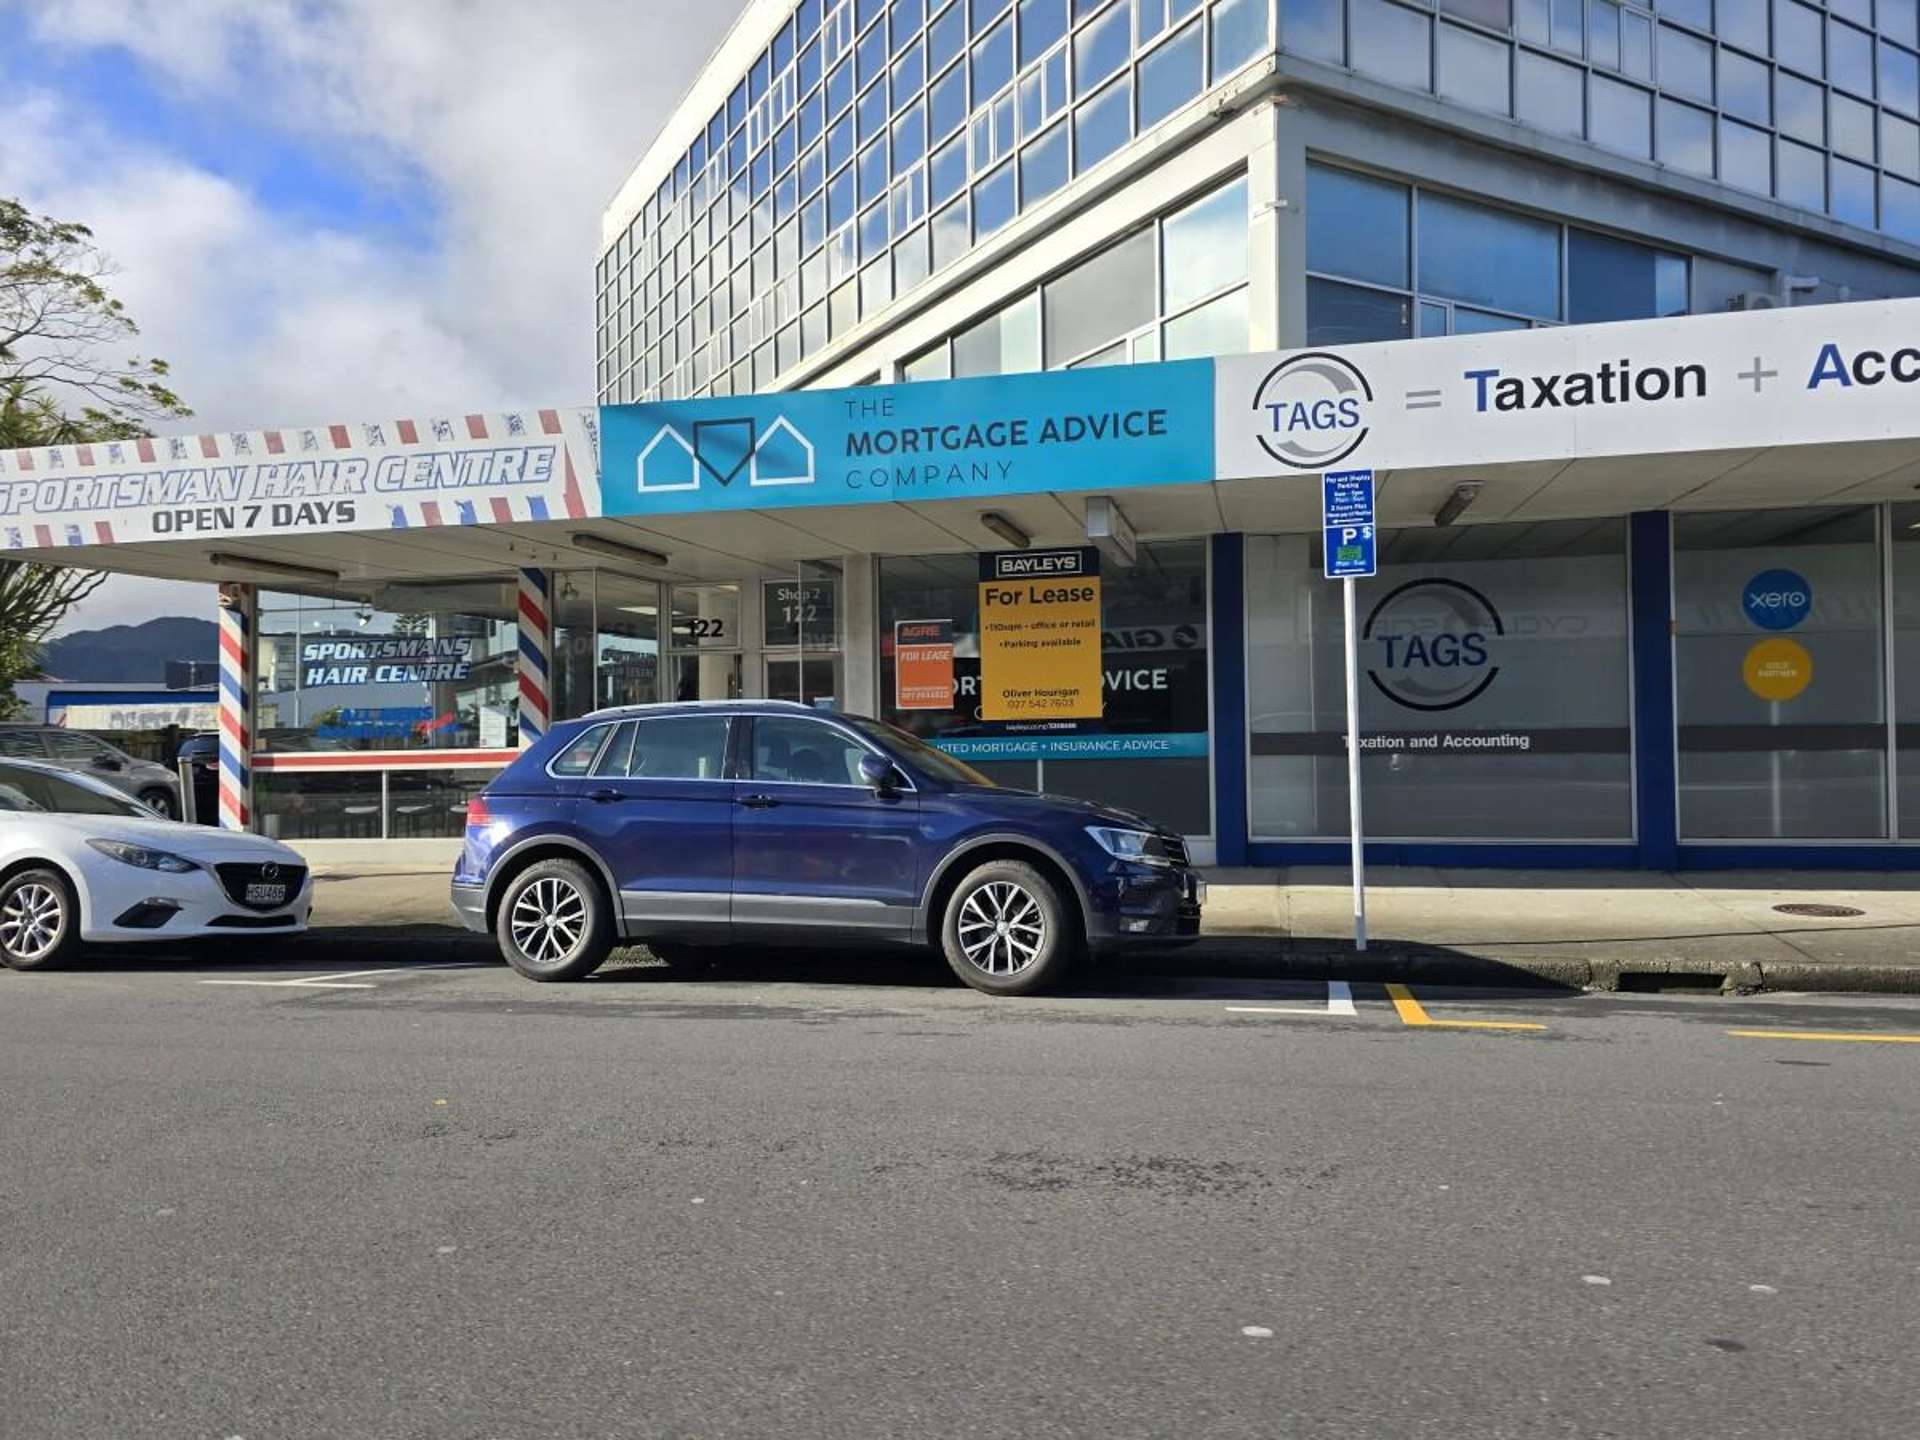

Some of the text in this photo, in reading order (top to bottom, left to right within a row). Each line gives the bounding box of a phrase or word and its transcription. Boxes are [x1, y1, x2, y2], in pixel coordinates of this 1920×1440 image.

[1265, 397, 1360, 432] TAGS
[1463, 359, 1706, 412] Taxation
[844, 397, 895, 419] THE
[845, 408, 1168, 457] MORTGAGE ADVICE
[248, 457, 368, 501] HAIR
[374, 446, 556, 493] CENTRE
[846, 460, 1013, 490] COMPANY
[152, 500, 356, 534] OPEN 7 DAYS
[1342, 528, 1358, 546] P
[1001, 556, 1076, 573] BAYLEYS
[777, 588, 810, 601] Shop
[985, 586, 1094, 606] For Lease
[1750, 592, 1806, 608] xero
[783, 604, 817, 623] 122
[689, 618, 724, 638] 122
[303, 639, 472, 661] SPORTSMANS
[1378, 633, 1487, 668] TAGS
[306, 663, 468, 685] HAIR CENTRE
[1101, 668, 1168, 691] VICE
[972, 742, 1037, 753] MORTGAGE
[1050, 740, 1121, 751] INSURANCE
[1123, 740, 1169, 750] ADVICE
[1410, 735, 1437, 747] and
[1443, 734, 1530, 749] Accounting
